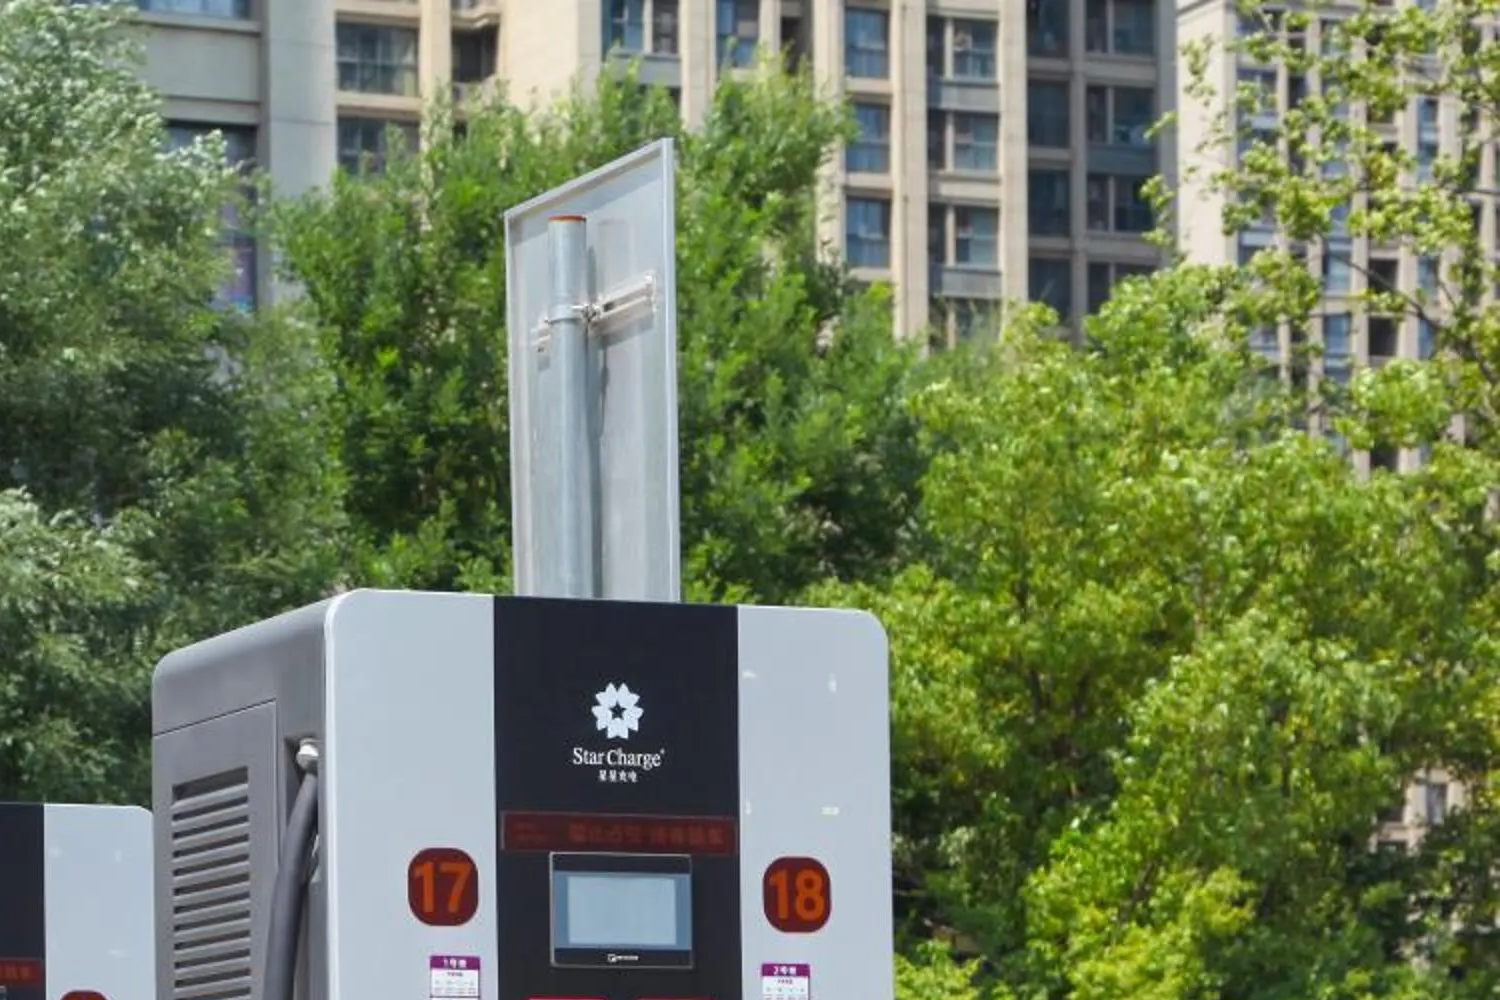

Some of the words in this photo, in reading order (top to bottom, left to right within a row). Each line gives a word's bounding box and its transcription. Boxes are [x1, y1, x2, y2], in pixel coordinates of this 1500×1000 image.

[573, 747, 605, 765] Star
[607, 748, 661, 770] Charge
[414, 862, 471, 913] 17
[770, 869, 824, 920] 18
